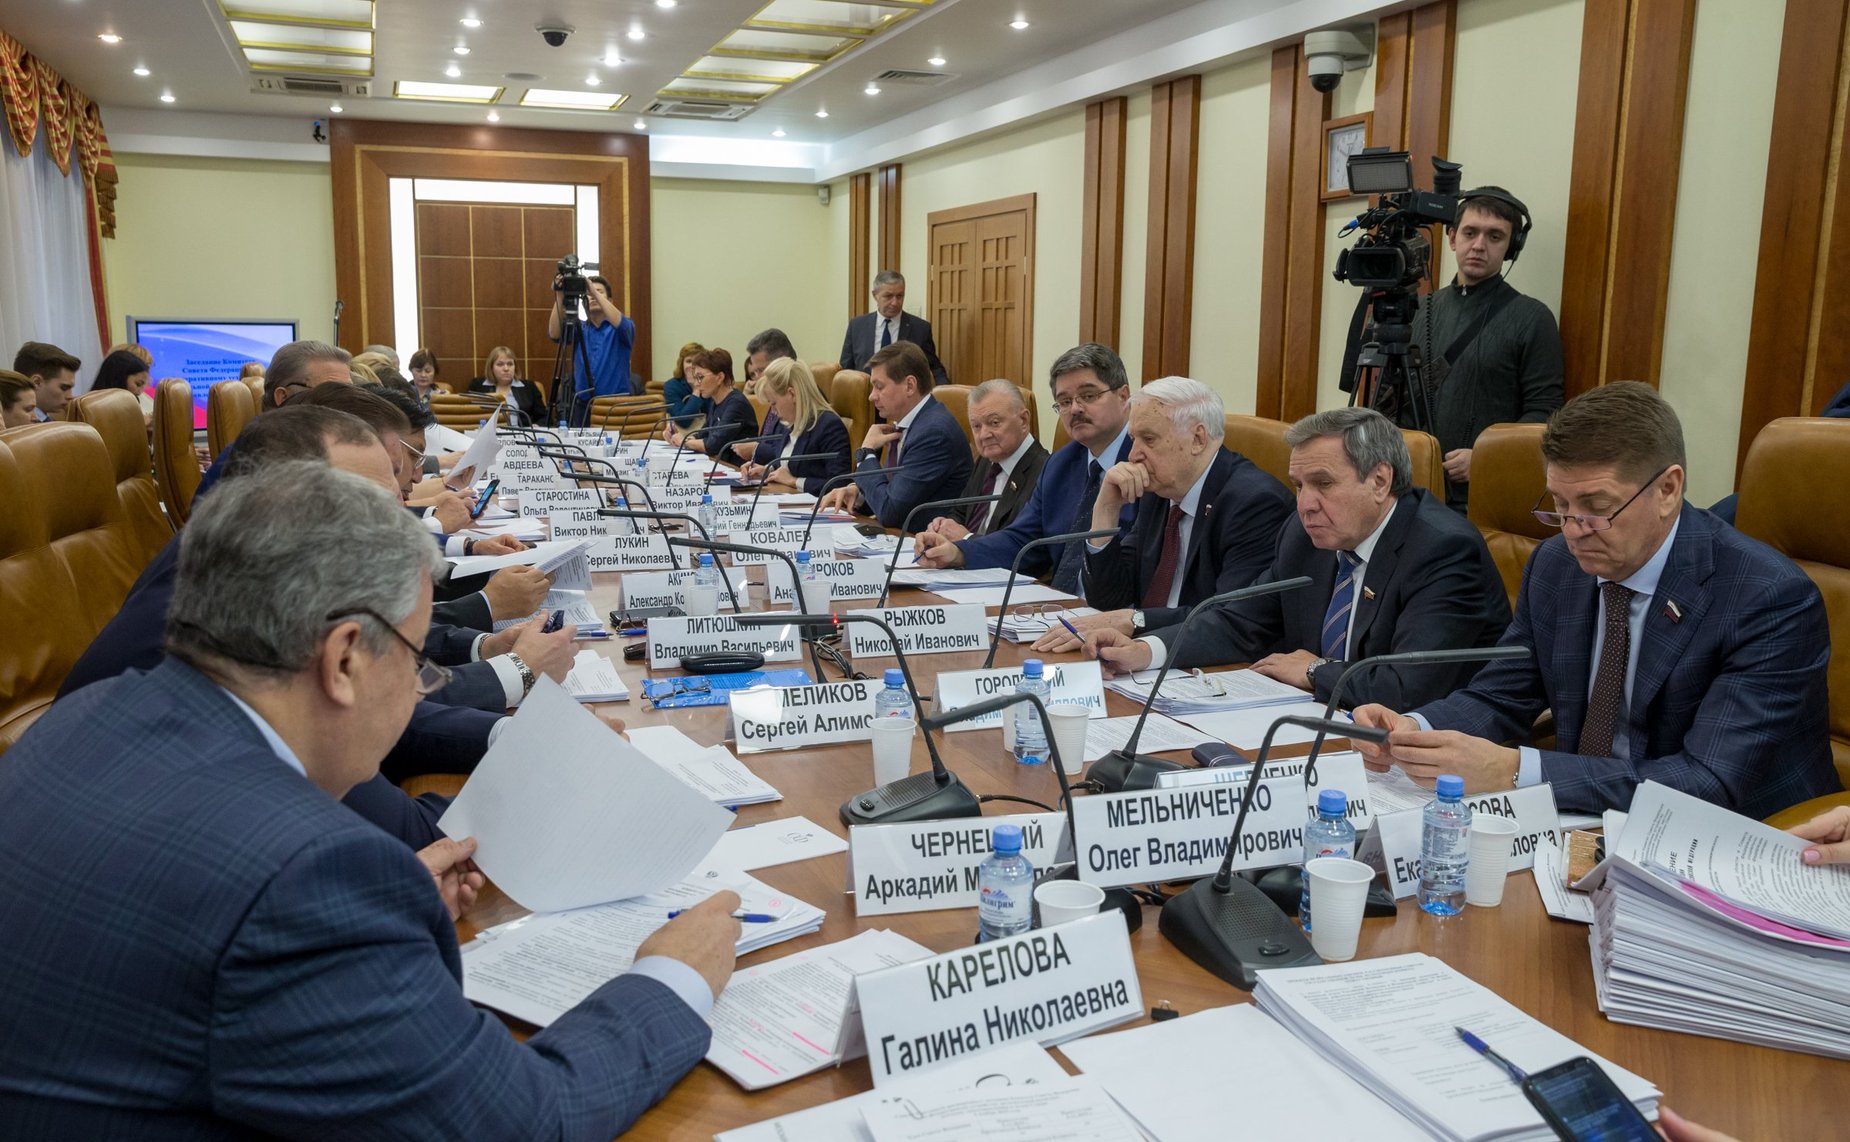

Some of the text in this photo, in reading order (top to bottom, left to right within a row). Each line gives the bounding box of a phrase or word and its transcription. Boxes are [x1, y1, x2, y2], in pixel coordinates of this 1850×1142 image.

[578, 439, 605, 447] КУСАЙО
[503, 461, 544, 471] АВДЕЕВА
[535, 491, 590, 502] СТАРОСТИНА
[523, 506, 548, 516] Ольга
[652, 500, 684, 511] Виктор
[554, 526, 588, 538] Виктор
[614, 536, 650, 549] ЛУКИН
[621, 552, 683, 566] Николаевч
[830, 582, 884, 597] Иванович
[629, 593, 673, 609] Александр
[883, 608, 947, 628] РЫЖКОВ
[720, 638, 795, 653] Васильевич
[914, 632, 980, 651] Иванович
[741, 713, 874, 742] Сергей Алимо
[1088, 843, 1142, 873] Олег
[864, 867, 959, 905] Аркадий
[926, 931, 1072, 1002] КАРЕЛОВА
[880, 978, 1130, 1076] Галина Николаевна
